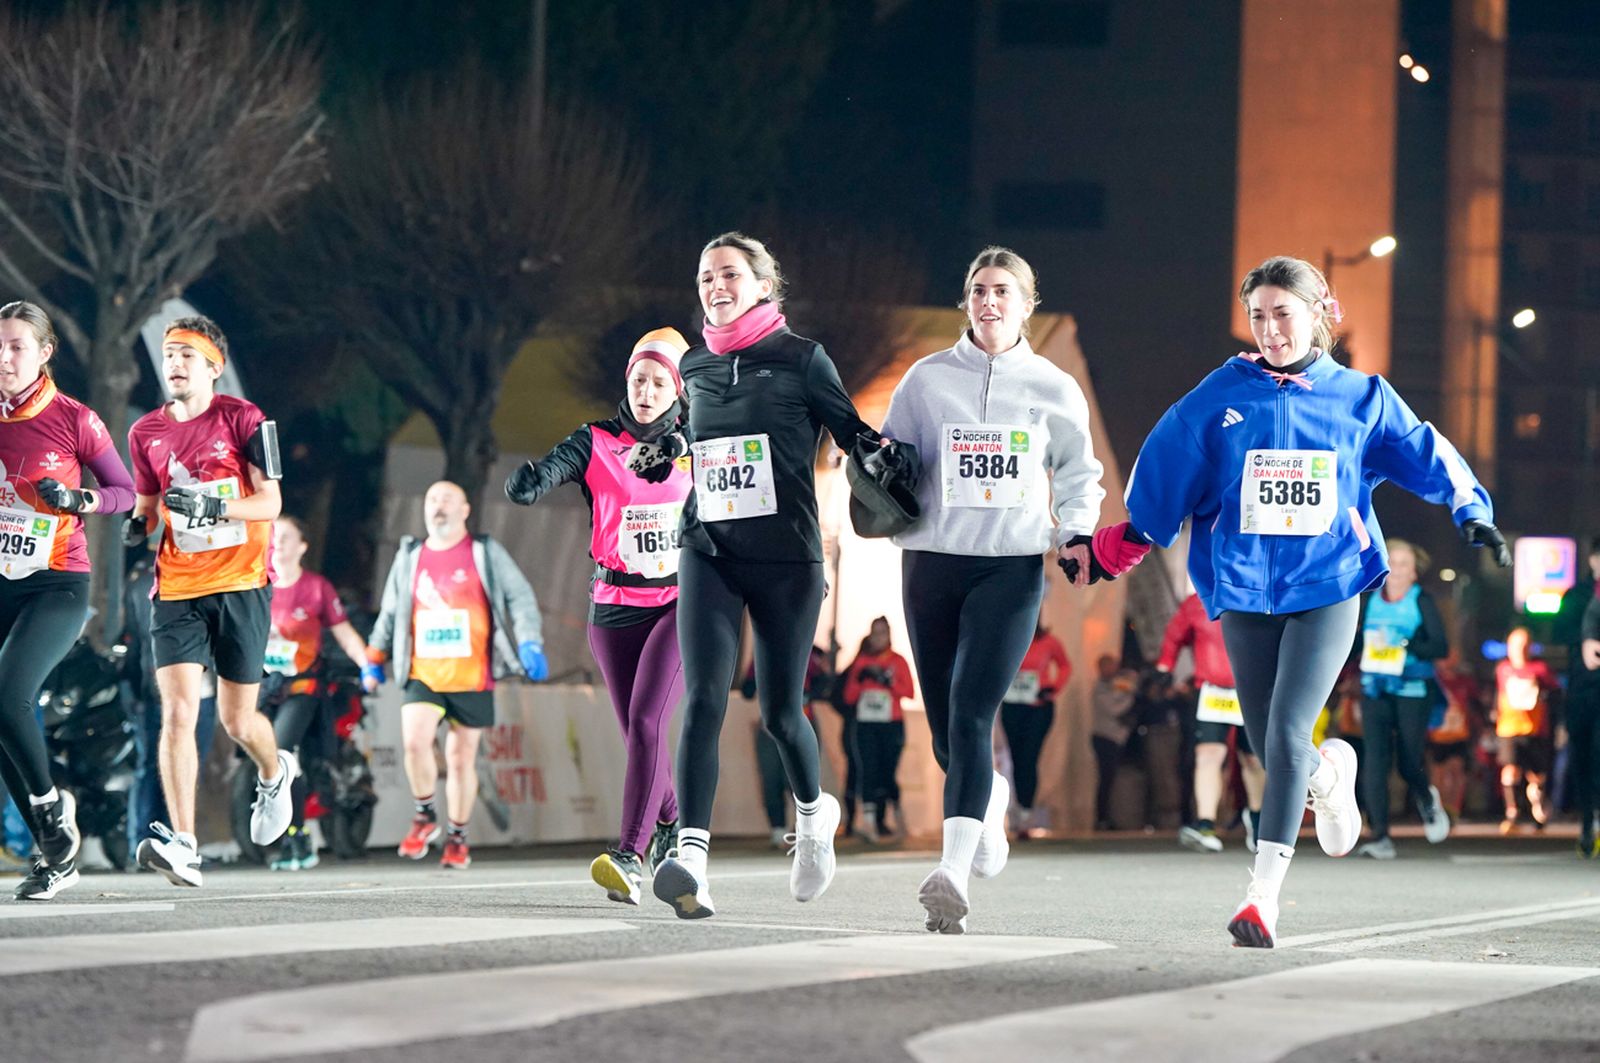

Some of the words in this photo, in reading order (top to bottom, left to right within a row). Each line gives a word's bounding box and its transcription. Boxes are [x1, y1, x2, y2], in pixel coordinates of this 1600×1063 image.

[963, 433, 991, 442] NOCHE
[992, 433, 1003, 442] DE
[952, 443, 971, 453] SAN
[959, 454, 1019, 479] 5384
[1264, 459, 1291, 468] NOCHE
[1292, 459, 1303, 469] DE
[706, 464, 756, 493] 6842
[1253, 468, 1271, 479] SAN
[1259, 480, 1321, 506] 5385
[634, 512, 658, 521] NOCHE
[626, 522, 641, 531] SAN
[0, 532, 37, 557] 295
